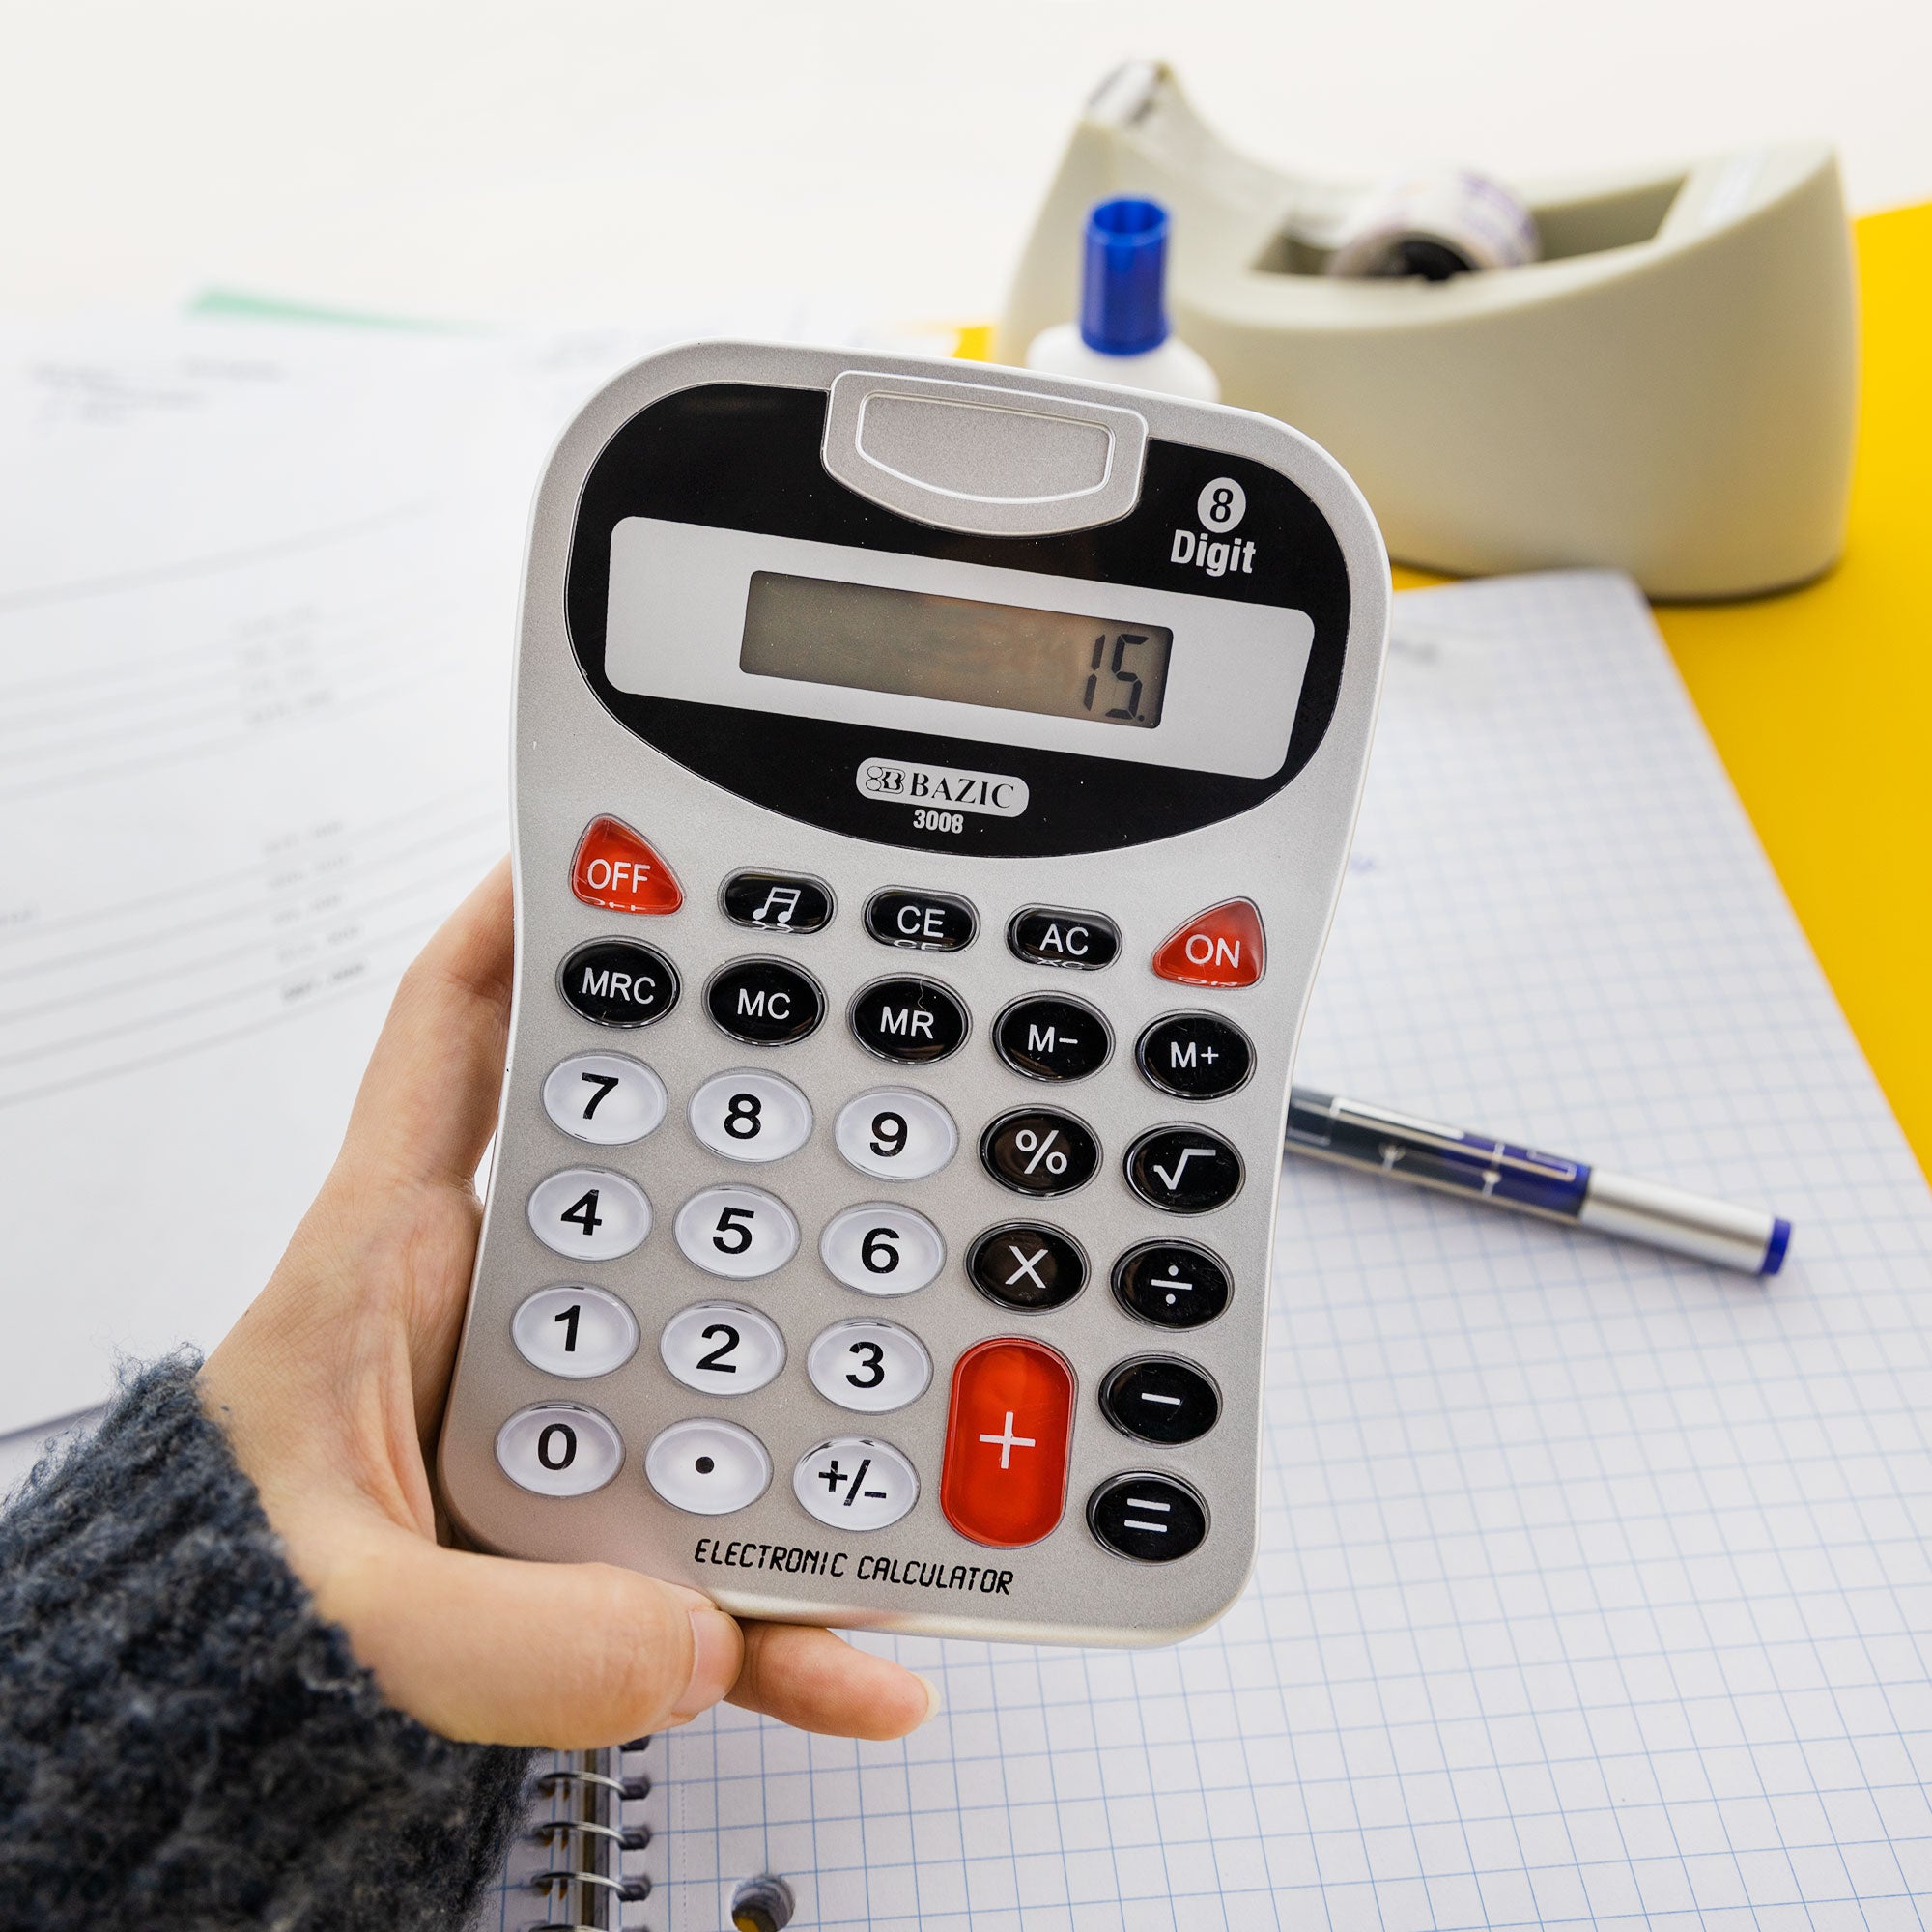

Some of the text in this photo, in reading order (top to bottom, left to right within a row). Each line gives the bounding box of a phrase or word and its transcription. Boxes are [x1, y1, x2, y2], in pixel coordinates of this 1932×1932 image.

[1210, 488, 1233, 523] 8
[1171, 528, 1257, 576] Digit
[909, 772, 1015, 809] BAZIC
[912, 809, 965, 835] 3008
[588, 859, 650, 893] OFF
[898, 906, 945, 938] CE
[1039, 924, 1088, 955] AC
[1186, 934, 1240, 968] ON
[582, 968, 655, 1004] MRC
[738, 989, 790, 1019] MC
[881, 1007, 933, 1038] MR
[1171, 1042, 1218, 1067] M+
[582, 1072, 618, 1120] 7
[724, 1094, 761, 1139] 8
[870, 1112, 907, 1157] 9
[1016, 1130, 1067, 1174] %
[561, 1189, 602, 1236] 4
[713, 1207, 754, 1254] 5
[862, 1228, 899, 1273] 6
[555, 1305, 580, 1351] 1
[696, 1324, 739, 1373] 2
[846, 1342, 884, 1388] 3
[538, 1423, 577, 1470] 0
[980, 1411, 1036, 1469] +
[1124, 1499, 1170, 1532] =
[694, 1538, 1014, 1595] ELECTRONIC CALCULATOR
